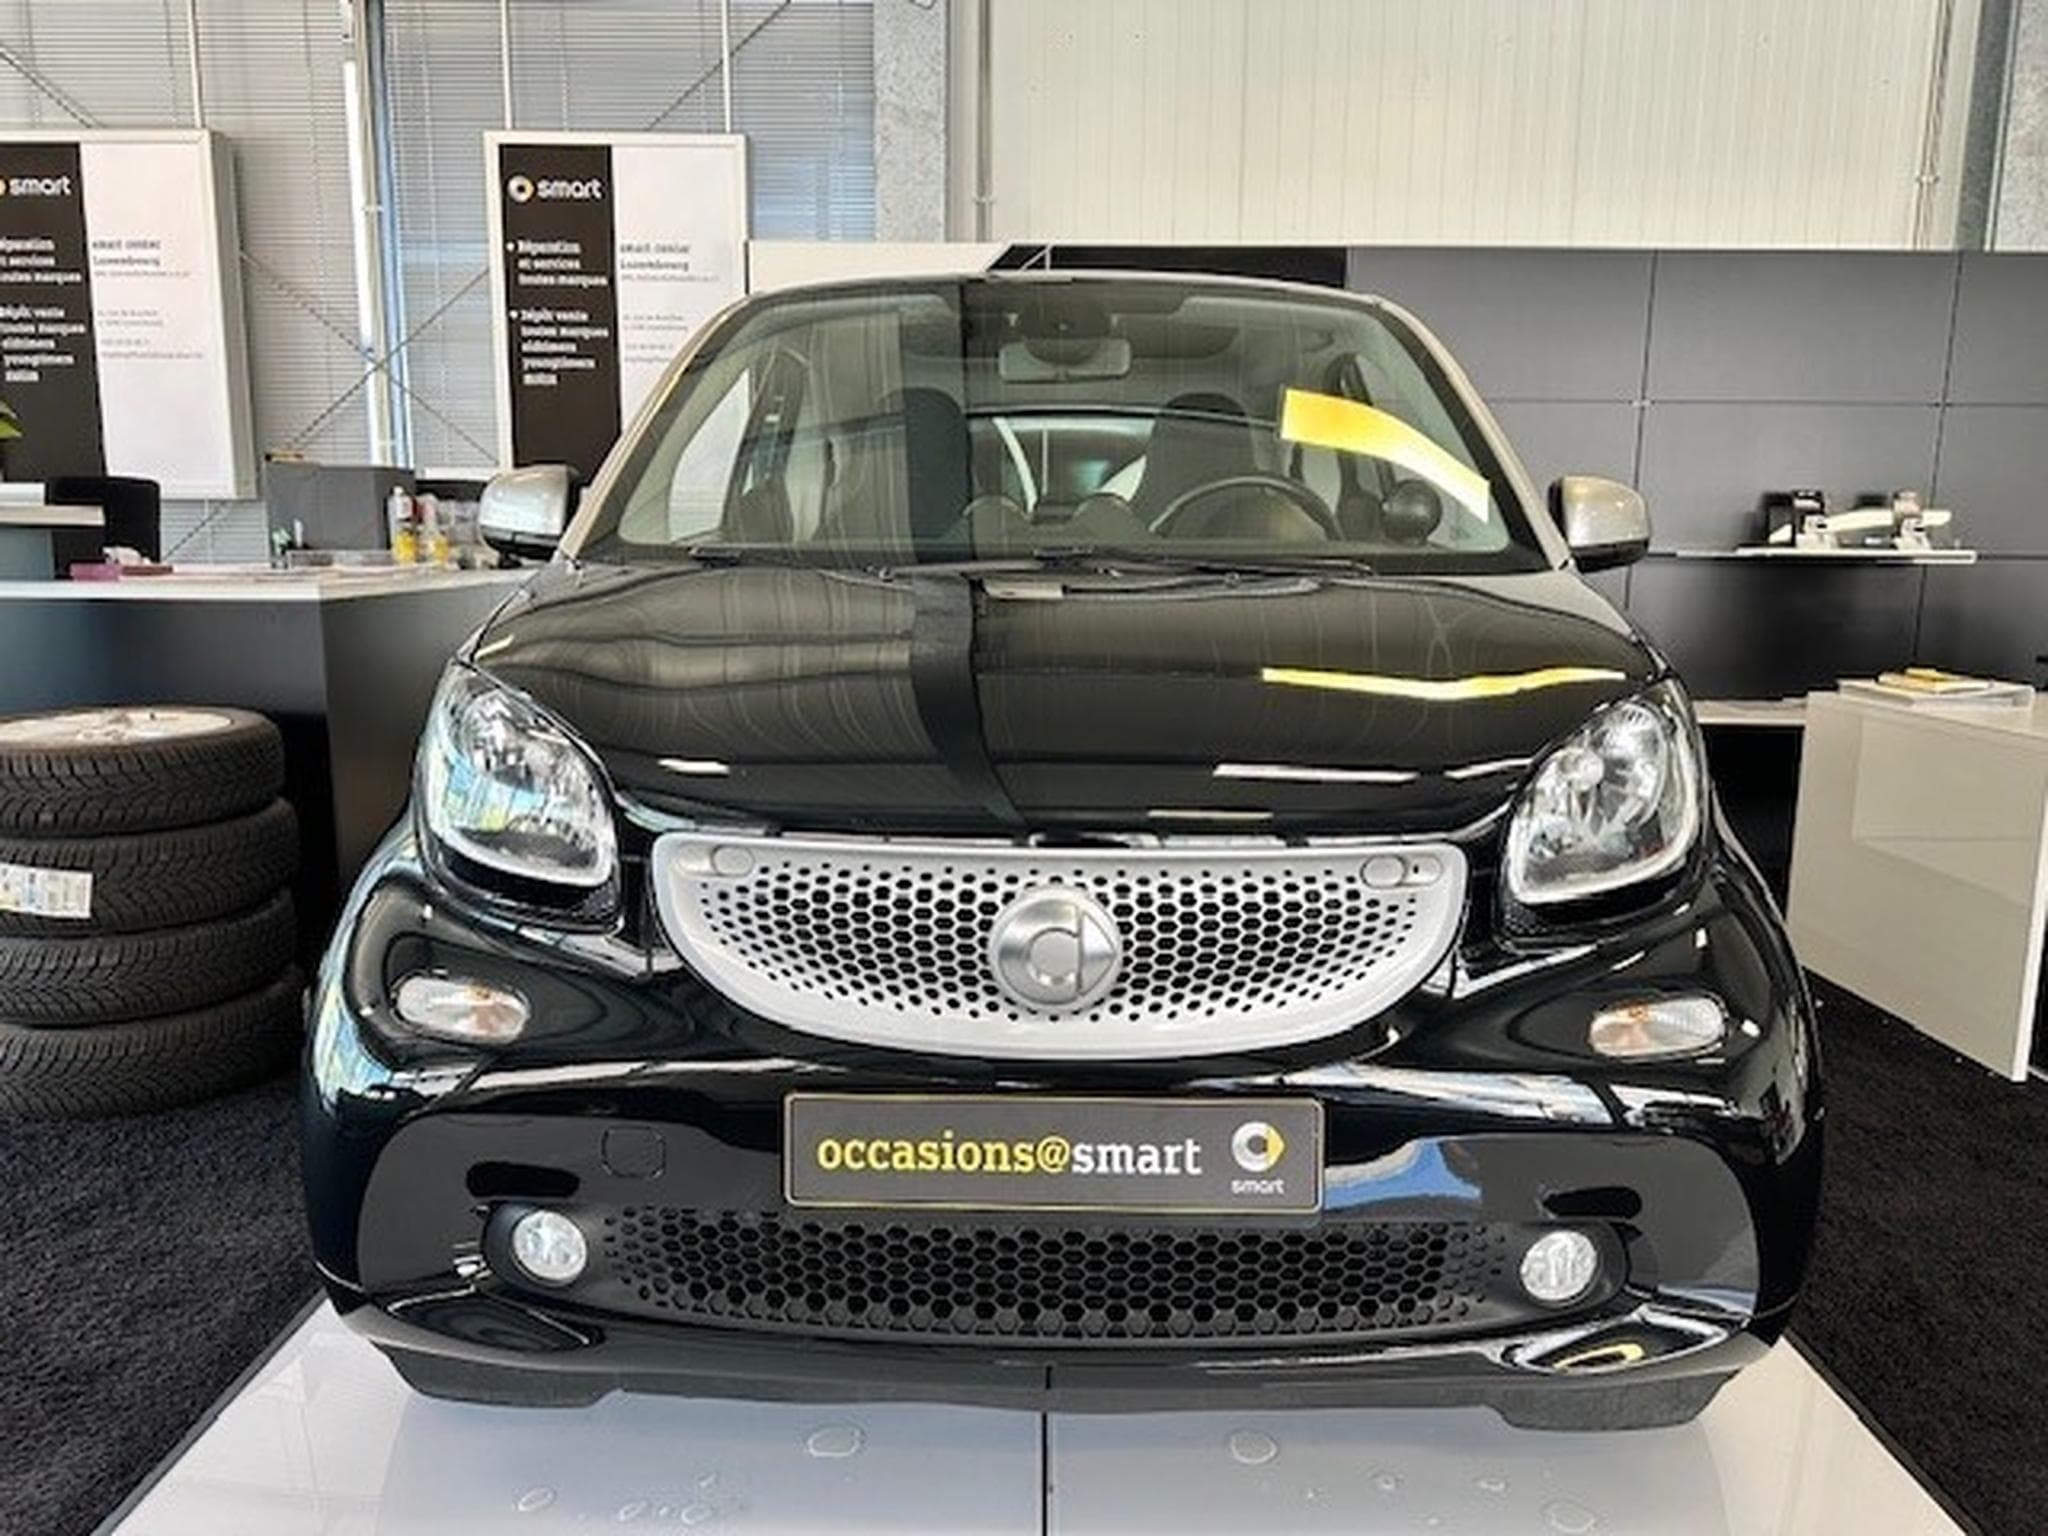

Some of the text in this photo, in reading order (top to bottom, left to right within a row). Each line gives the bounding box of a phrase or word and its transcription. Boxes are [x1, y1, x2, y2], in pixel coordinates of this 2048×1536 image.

[9, 176, 71, 196] smart
[537, 179, 603, 198] smart
[817, 1130, 1203, 1176] occasions@smart
[1231, 1178, 1285, 1194] smart
